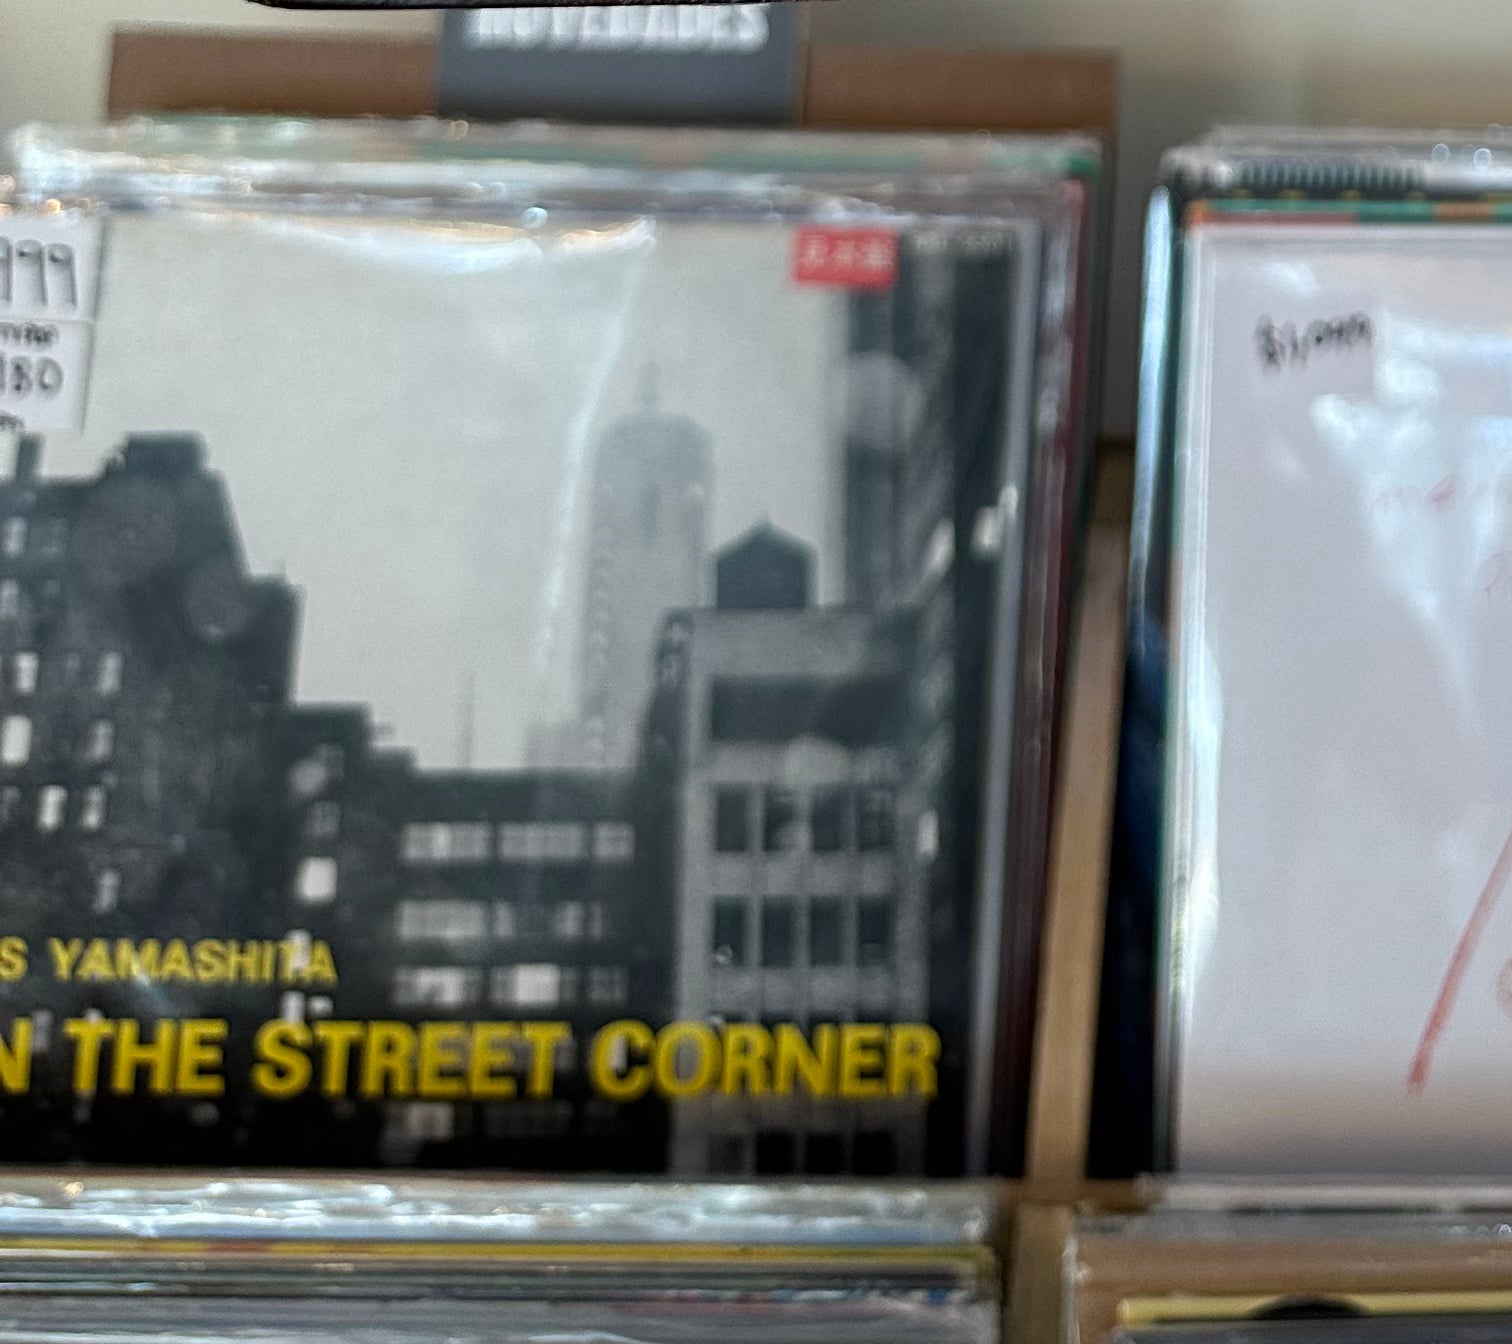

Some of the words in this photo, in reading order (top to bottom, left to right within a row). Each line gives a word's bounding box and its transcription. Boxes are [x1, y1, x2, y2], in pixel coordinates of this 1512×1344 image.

[49, 937, 338, 985] YAMASHITA
[64, 1018, 228, 1097] THE
[252, 1018, 573, 1100] STREET
[590, 1019, 942, 1101] CORNER
